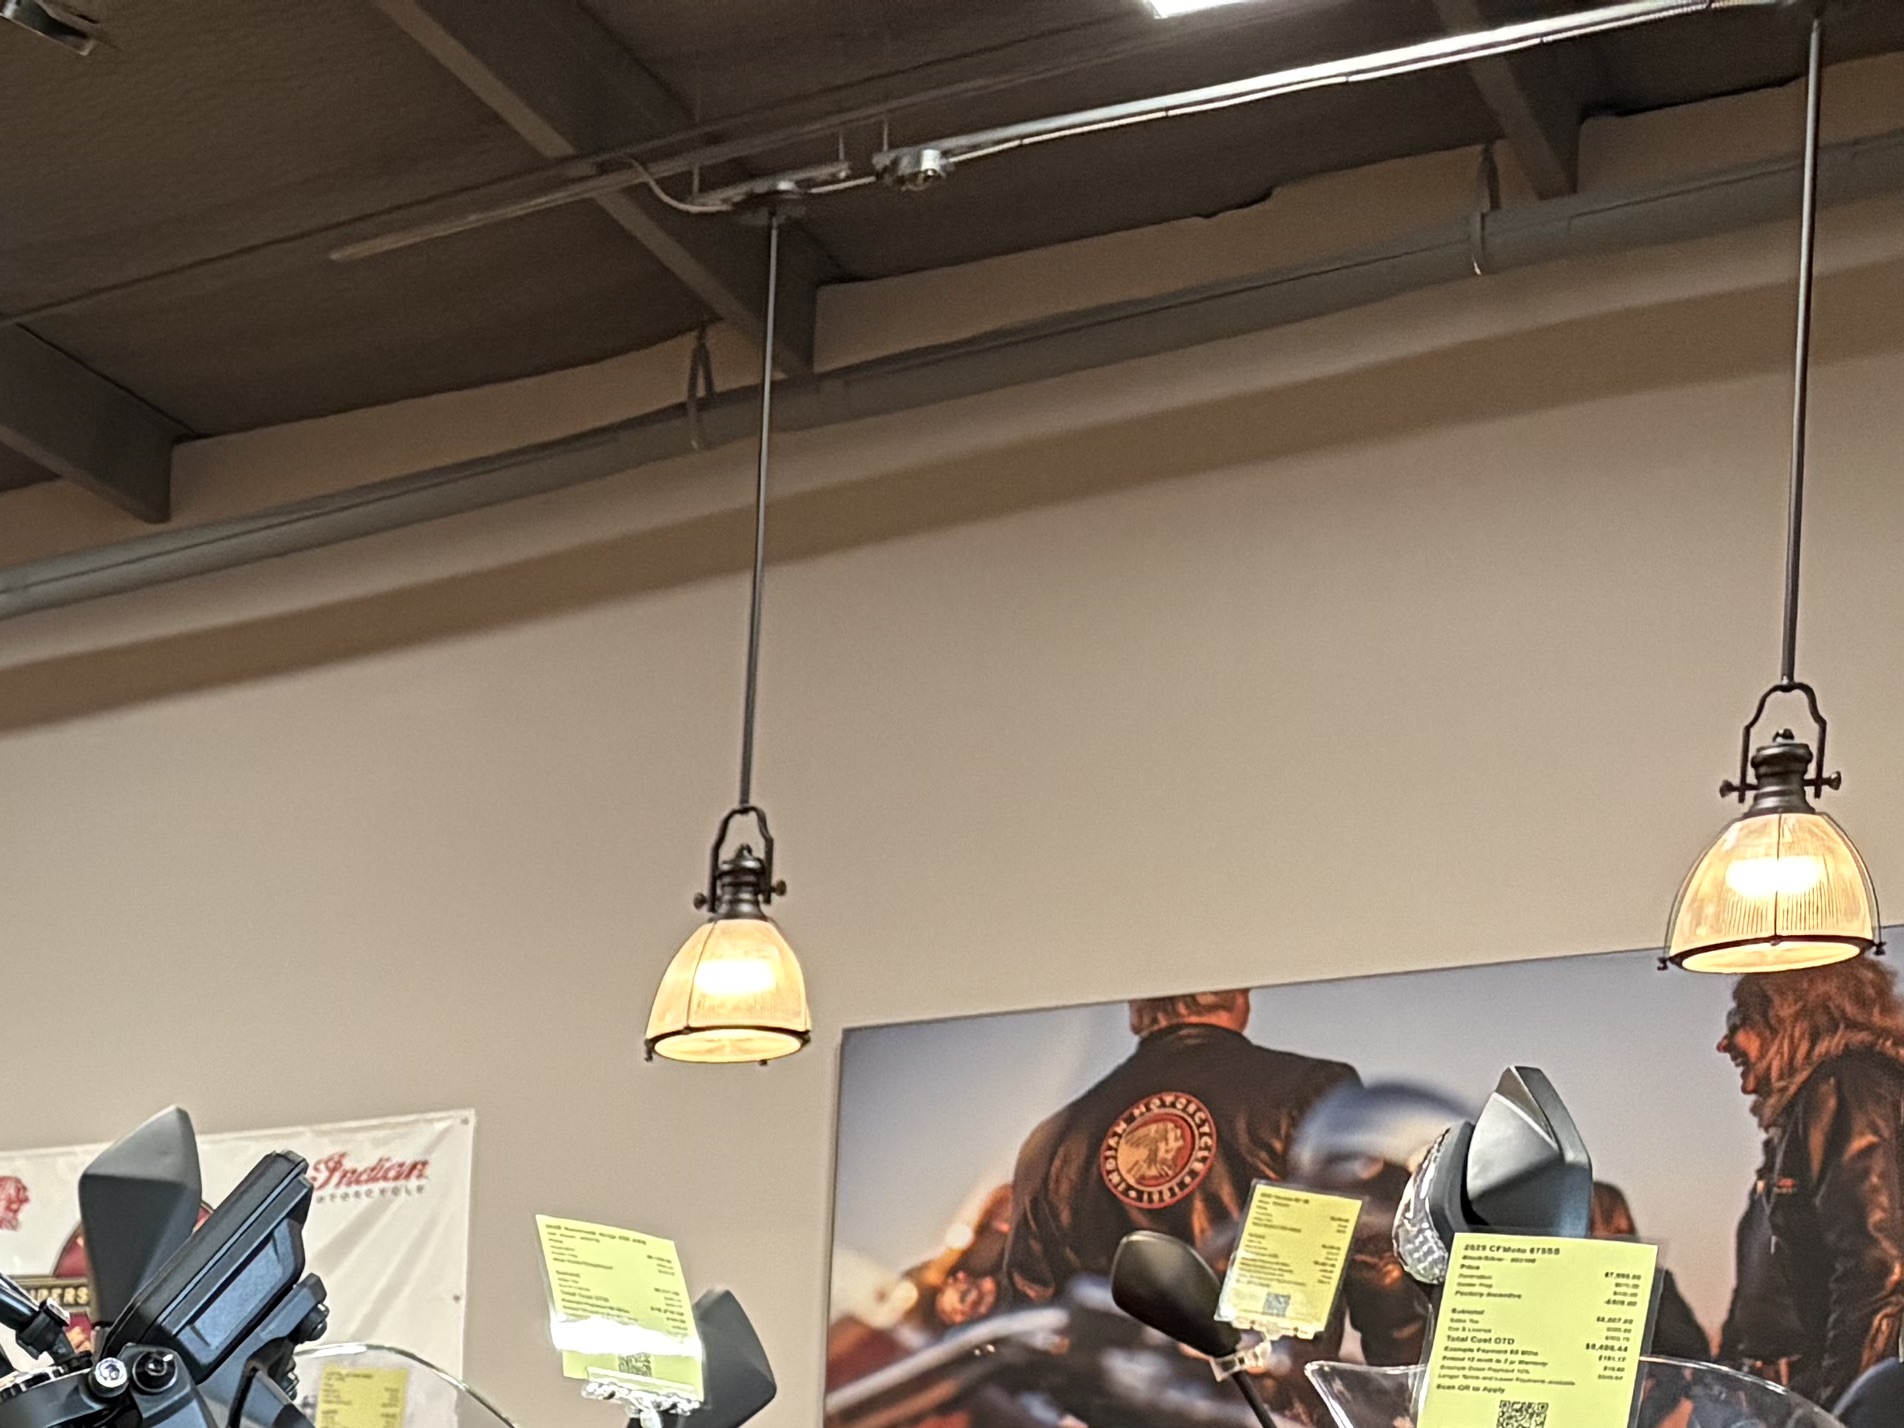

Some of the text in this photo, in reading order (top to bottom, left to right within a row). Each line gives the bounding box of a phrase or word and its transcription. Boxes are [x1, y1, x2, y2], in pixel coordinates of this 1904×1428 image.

[1132, 1094, 1212, 1172] MOTORCYCLE
[311, 1151, 430, 1191] Indian
[315, 1184, 425, 1204] OTORCYCLE
